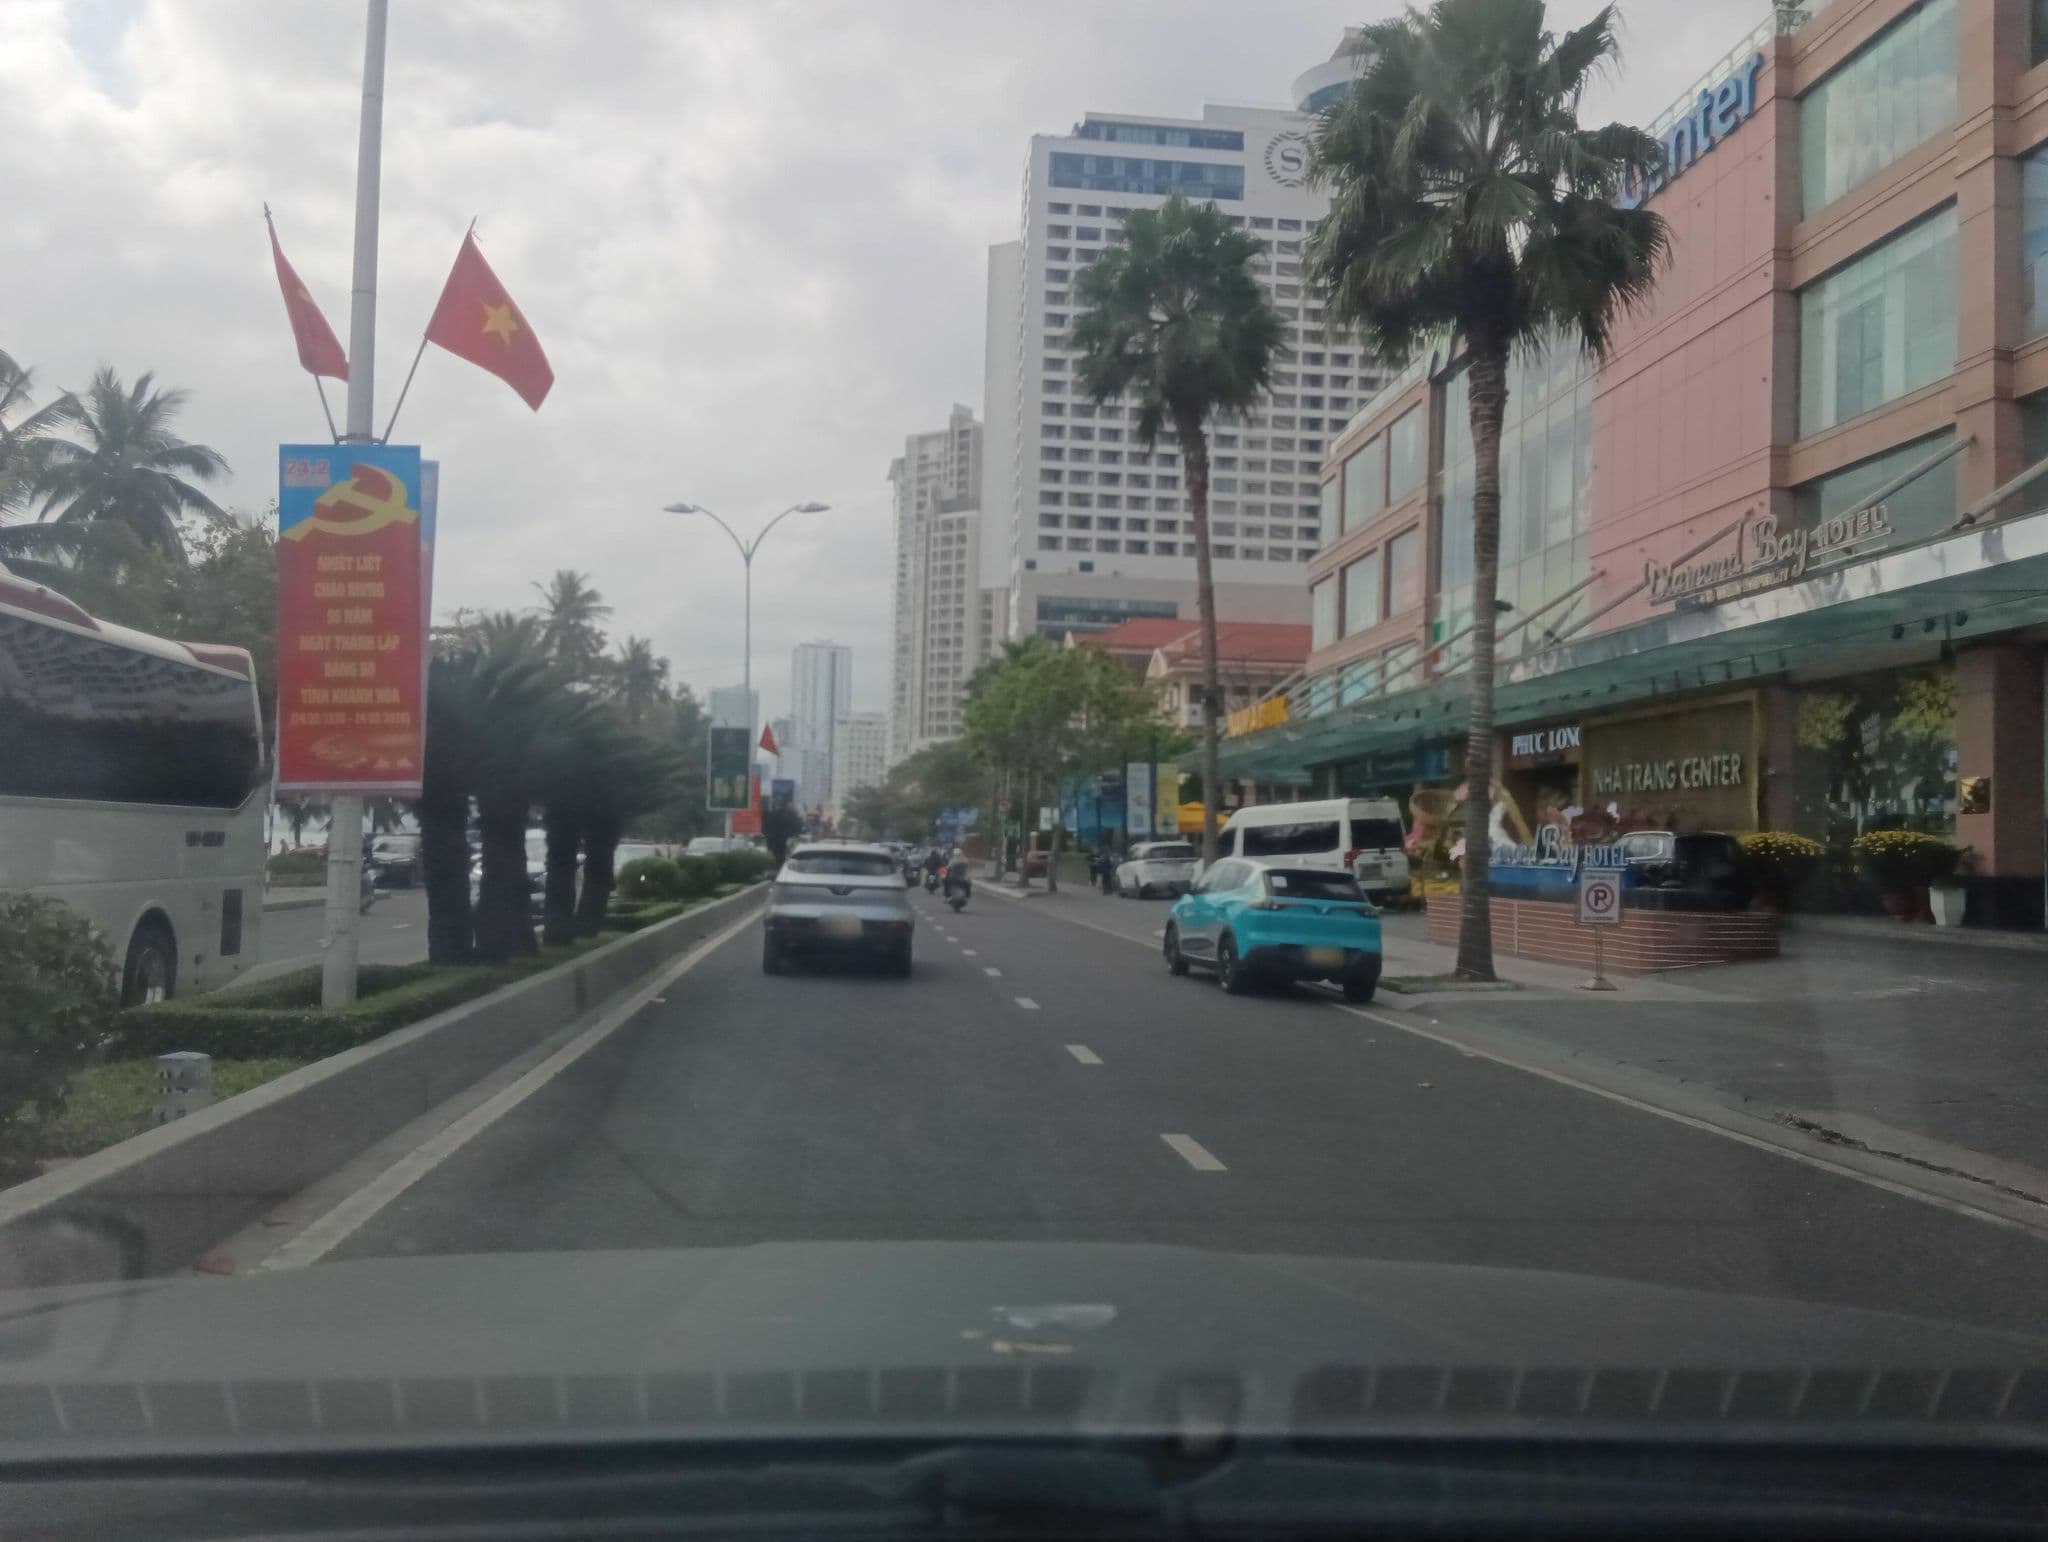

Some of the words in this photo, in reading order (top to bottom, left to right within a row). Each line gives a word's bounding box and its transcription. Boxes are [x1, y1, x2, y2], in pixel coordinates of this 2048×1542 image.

[1752, 513, 1809, 577] Bay
[1592, 767, 1623, 793] NHA
[1624, 759, 1677, 793] TRANG
[1679, 752, 1742, 788] CENTER
[1583, 844, 1628, 867] HOTEL
